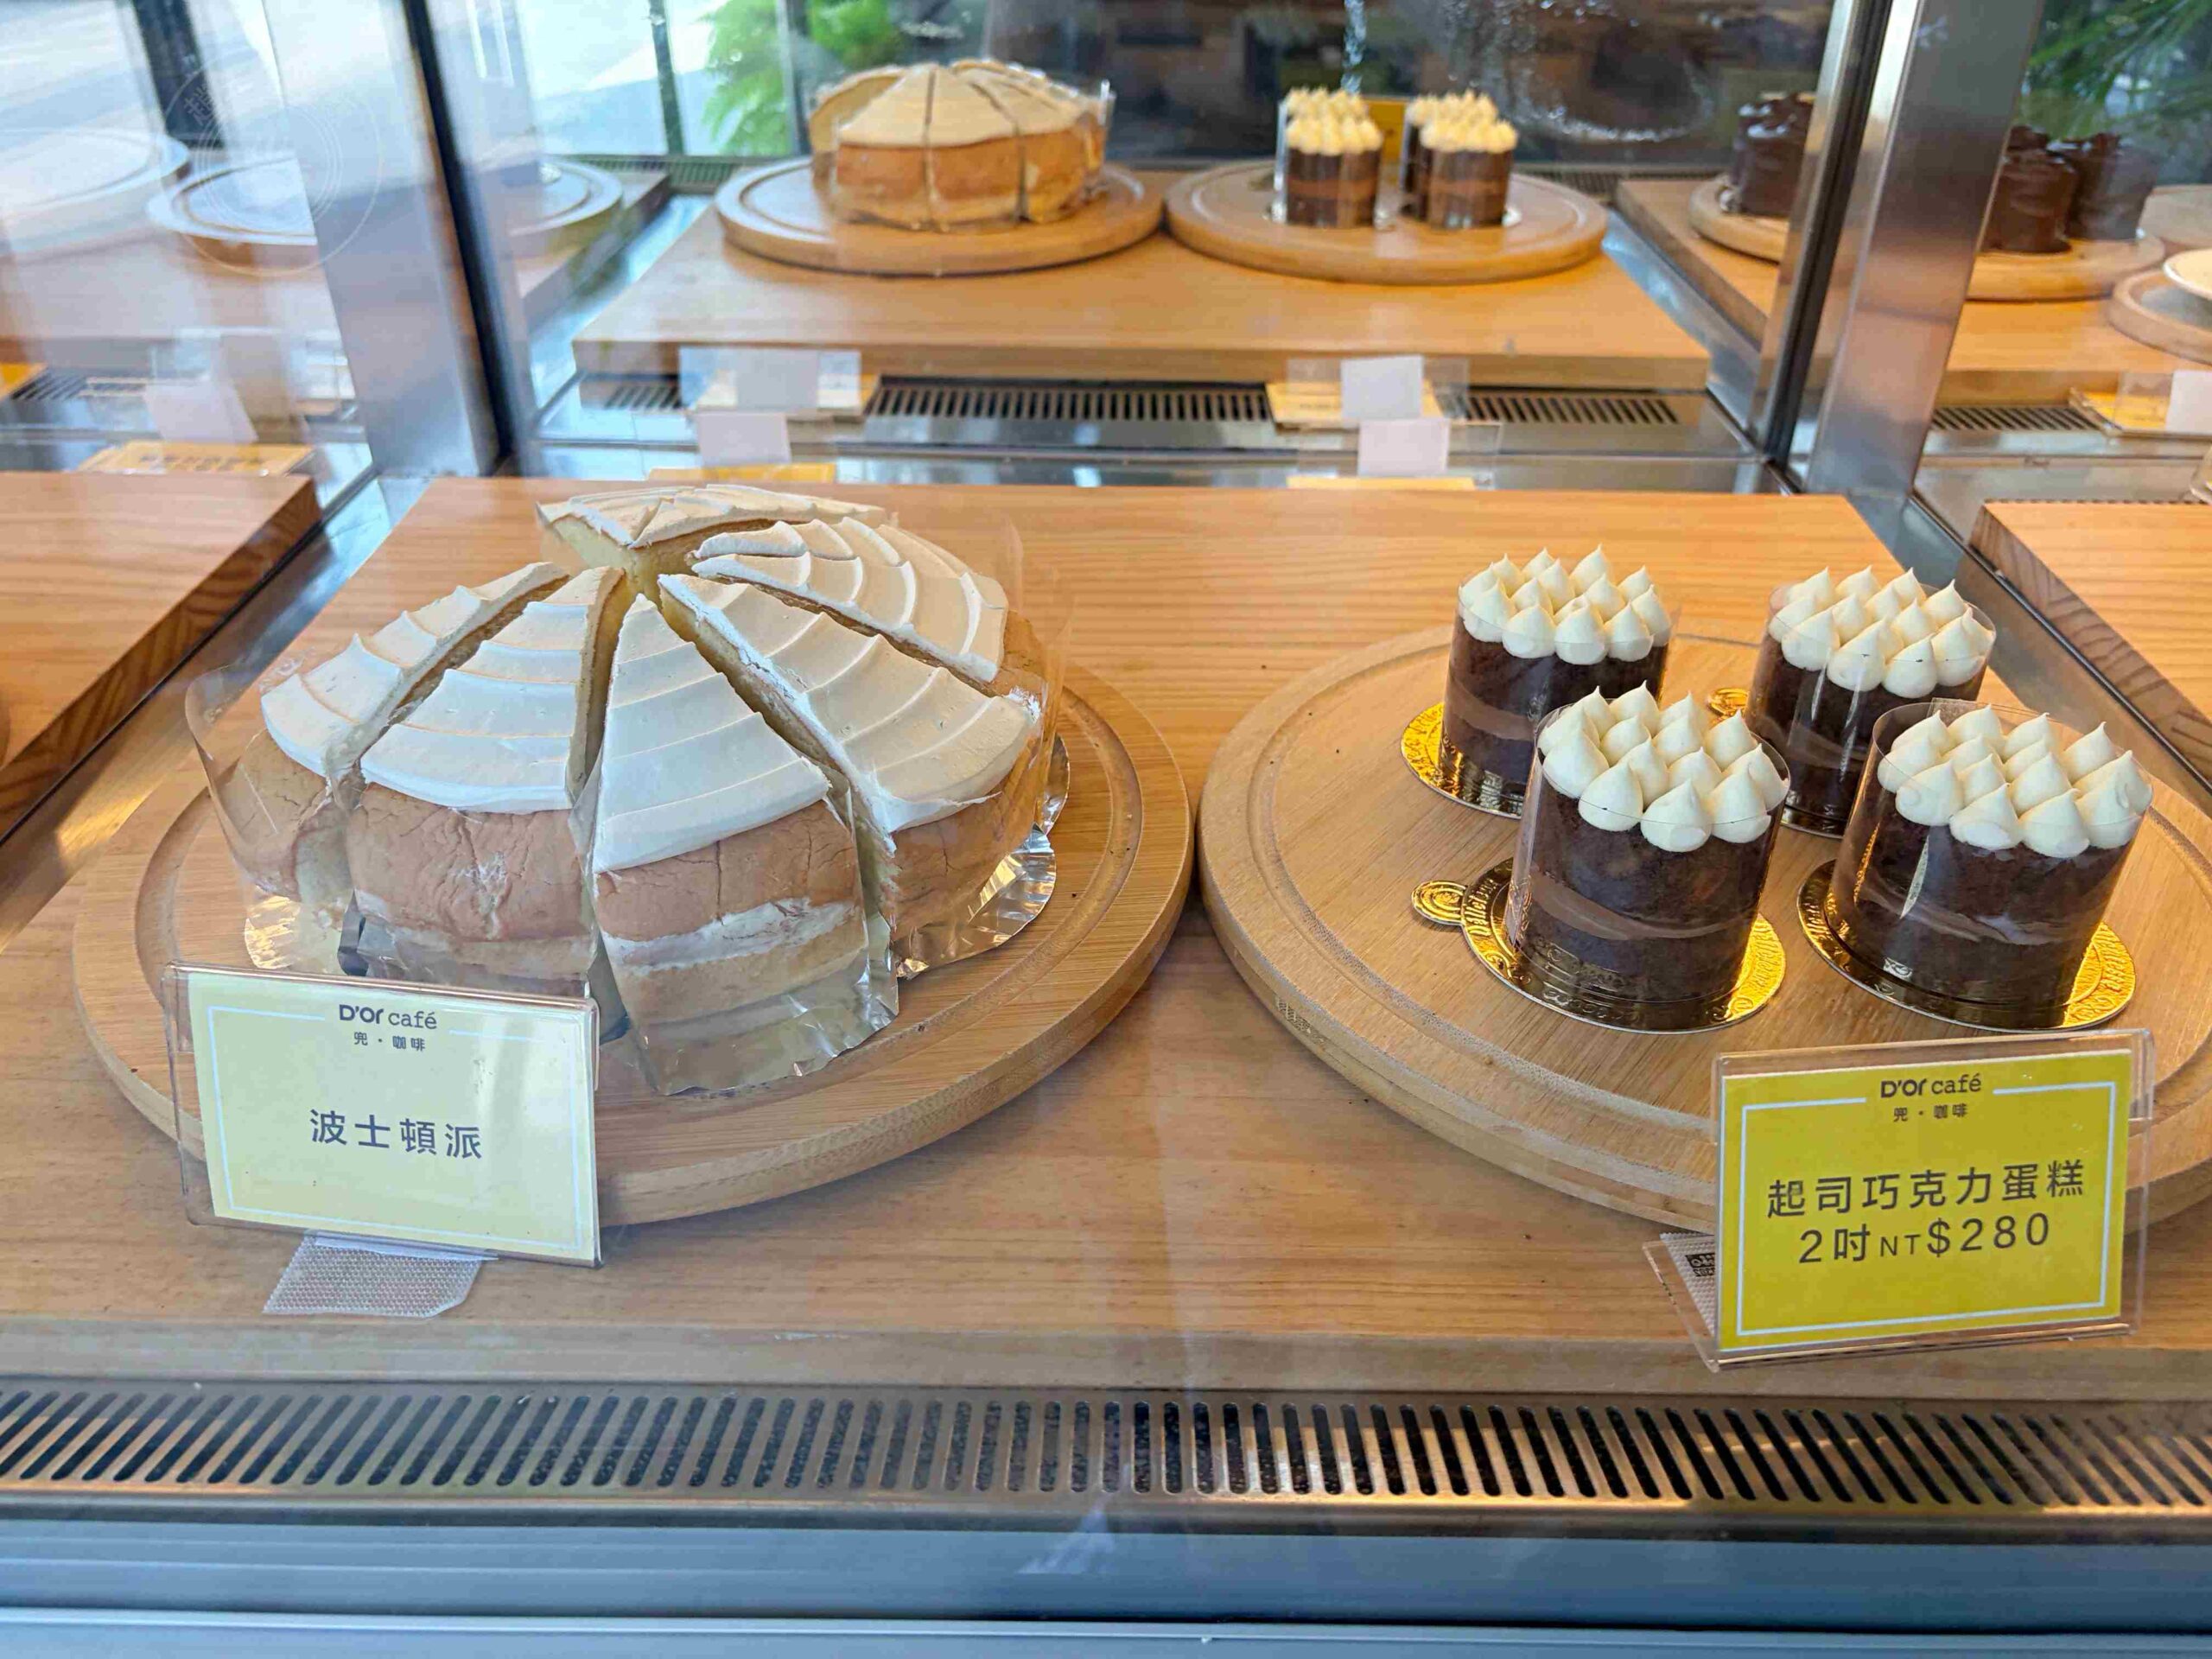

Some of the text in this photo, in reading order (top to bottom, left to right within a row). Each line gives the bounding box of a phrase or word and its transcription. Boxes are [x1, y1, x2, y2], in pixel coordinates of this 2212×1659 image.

[387, 1011, 437, 1029] café
[1931, 1072, 1982, 1095] café
[309, 1109, 482, 1159] 波士頓派
[1767, 1159, 2084, 1219] 起司巧克力蛋糕
